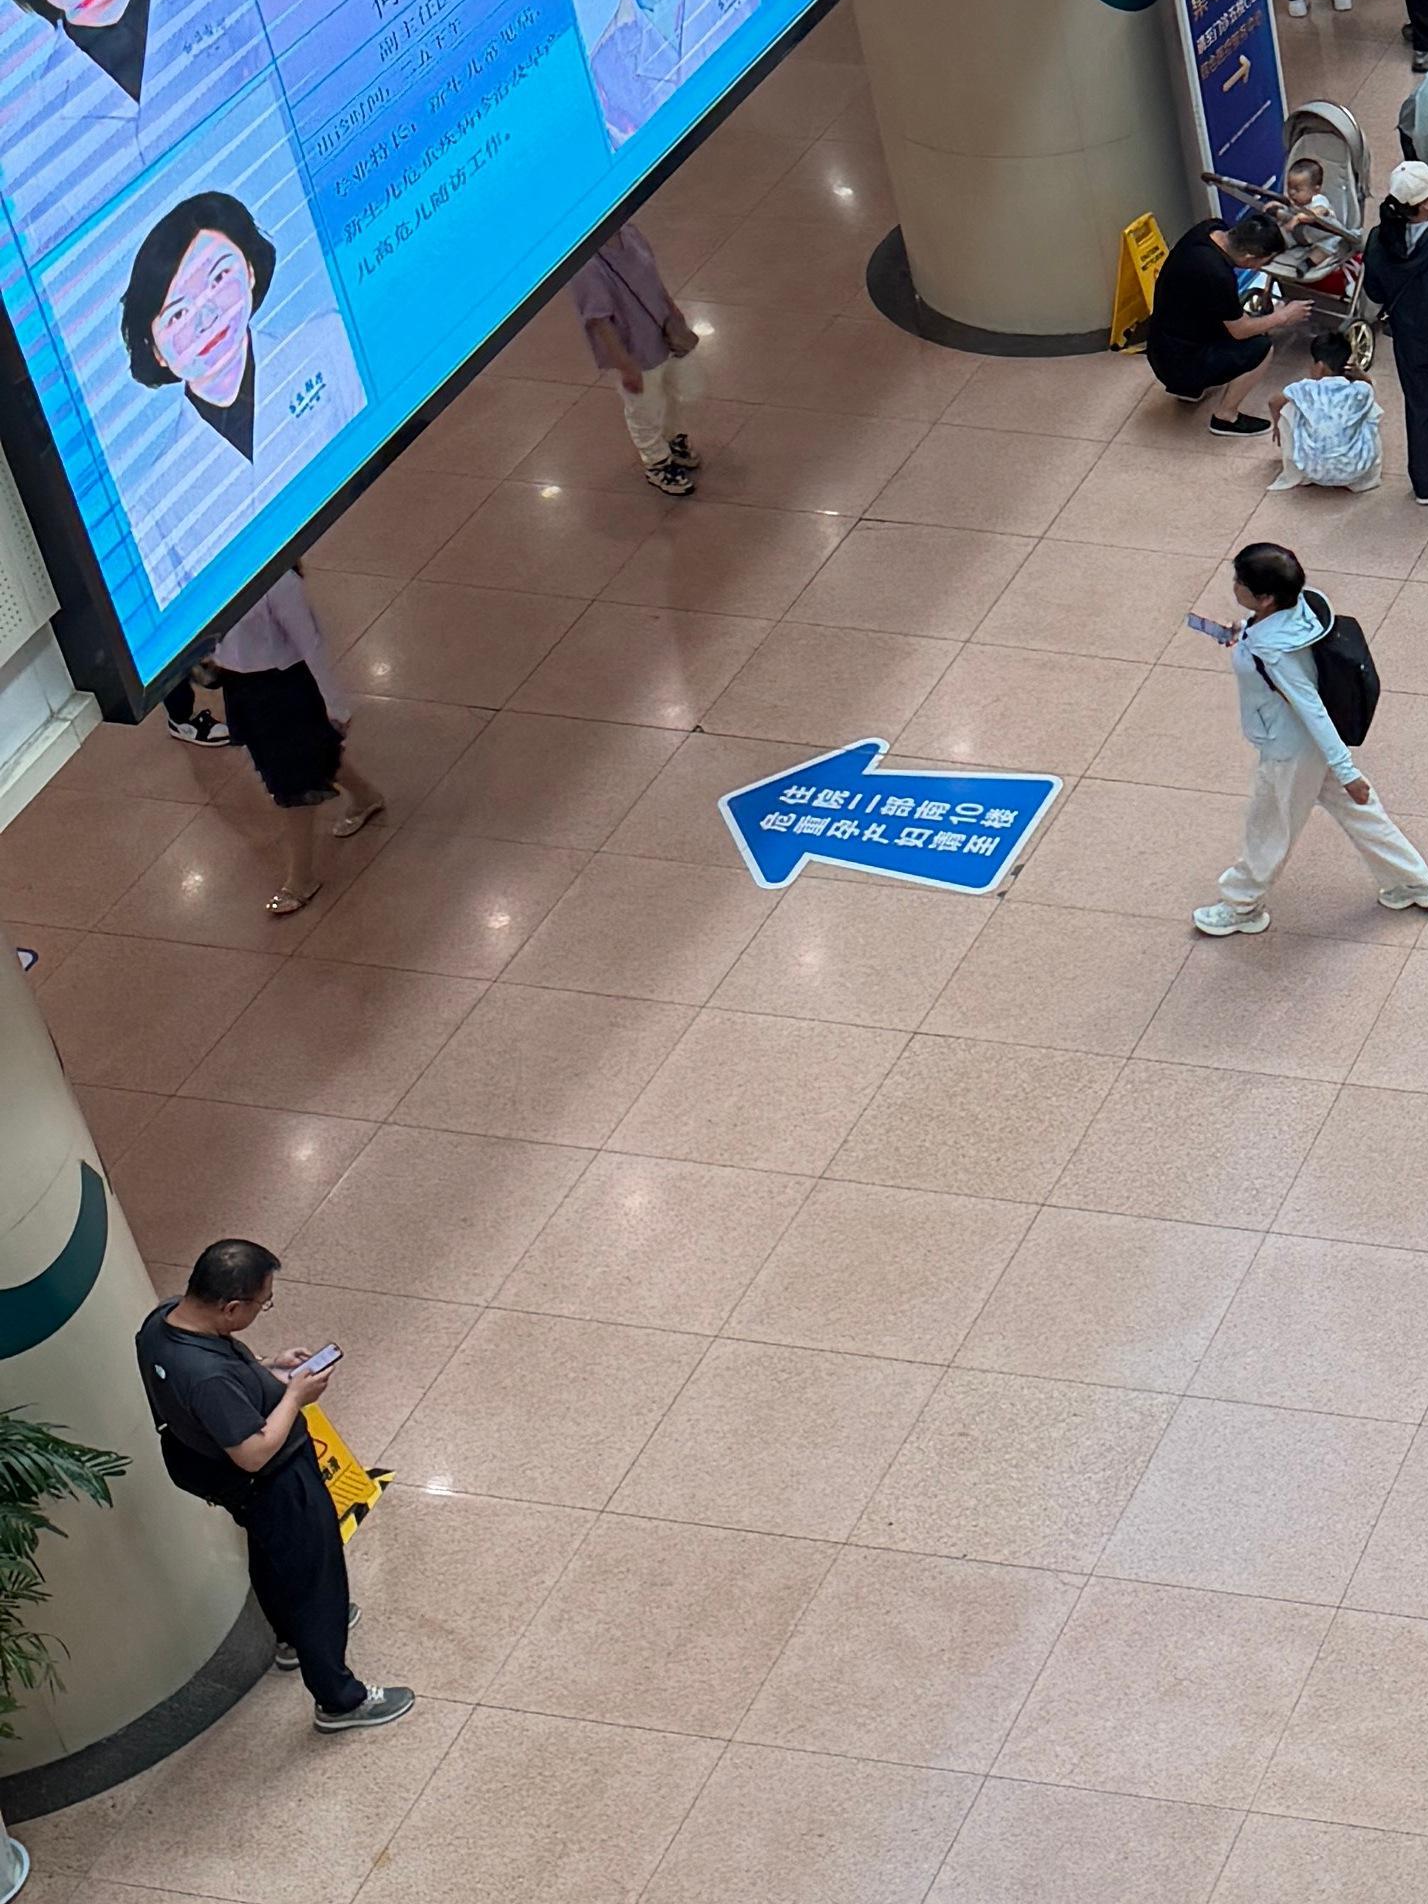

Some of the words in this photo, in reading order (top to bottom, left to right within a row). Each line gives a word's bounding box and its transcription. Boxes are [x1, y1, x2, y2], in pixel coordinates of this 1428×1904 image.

[779, 785, 1019, 829] 住院二部南10楼
[759, 811, 1000, 856] 危重孕产妇请至
